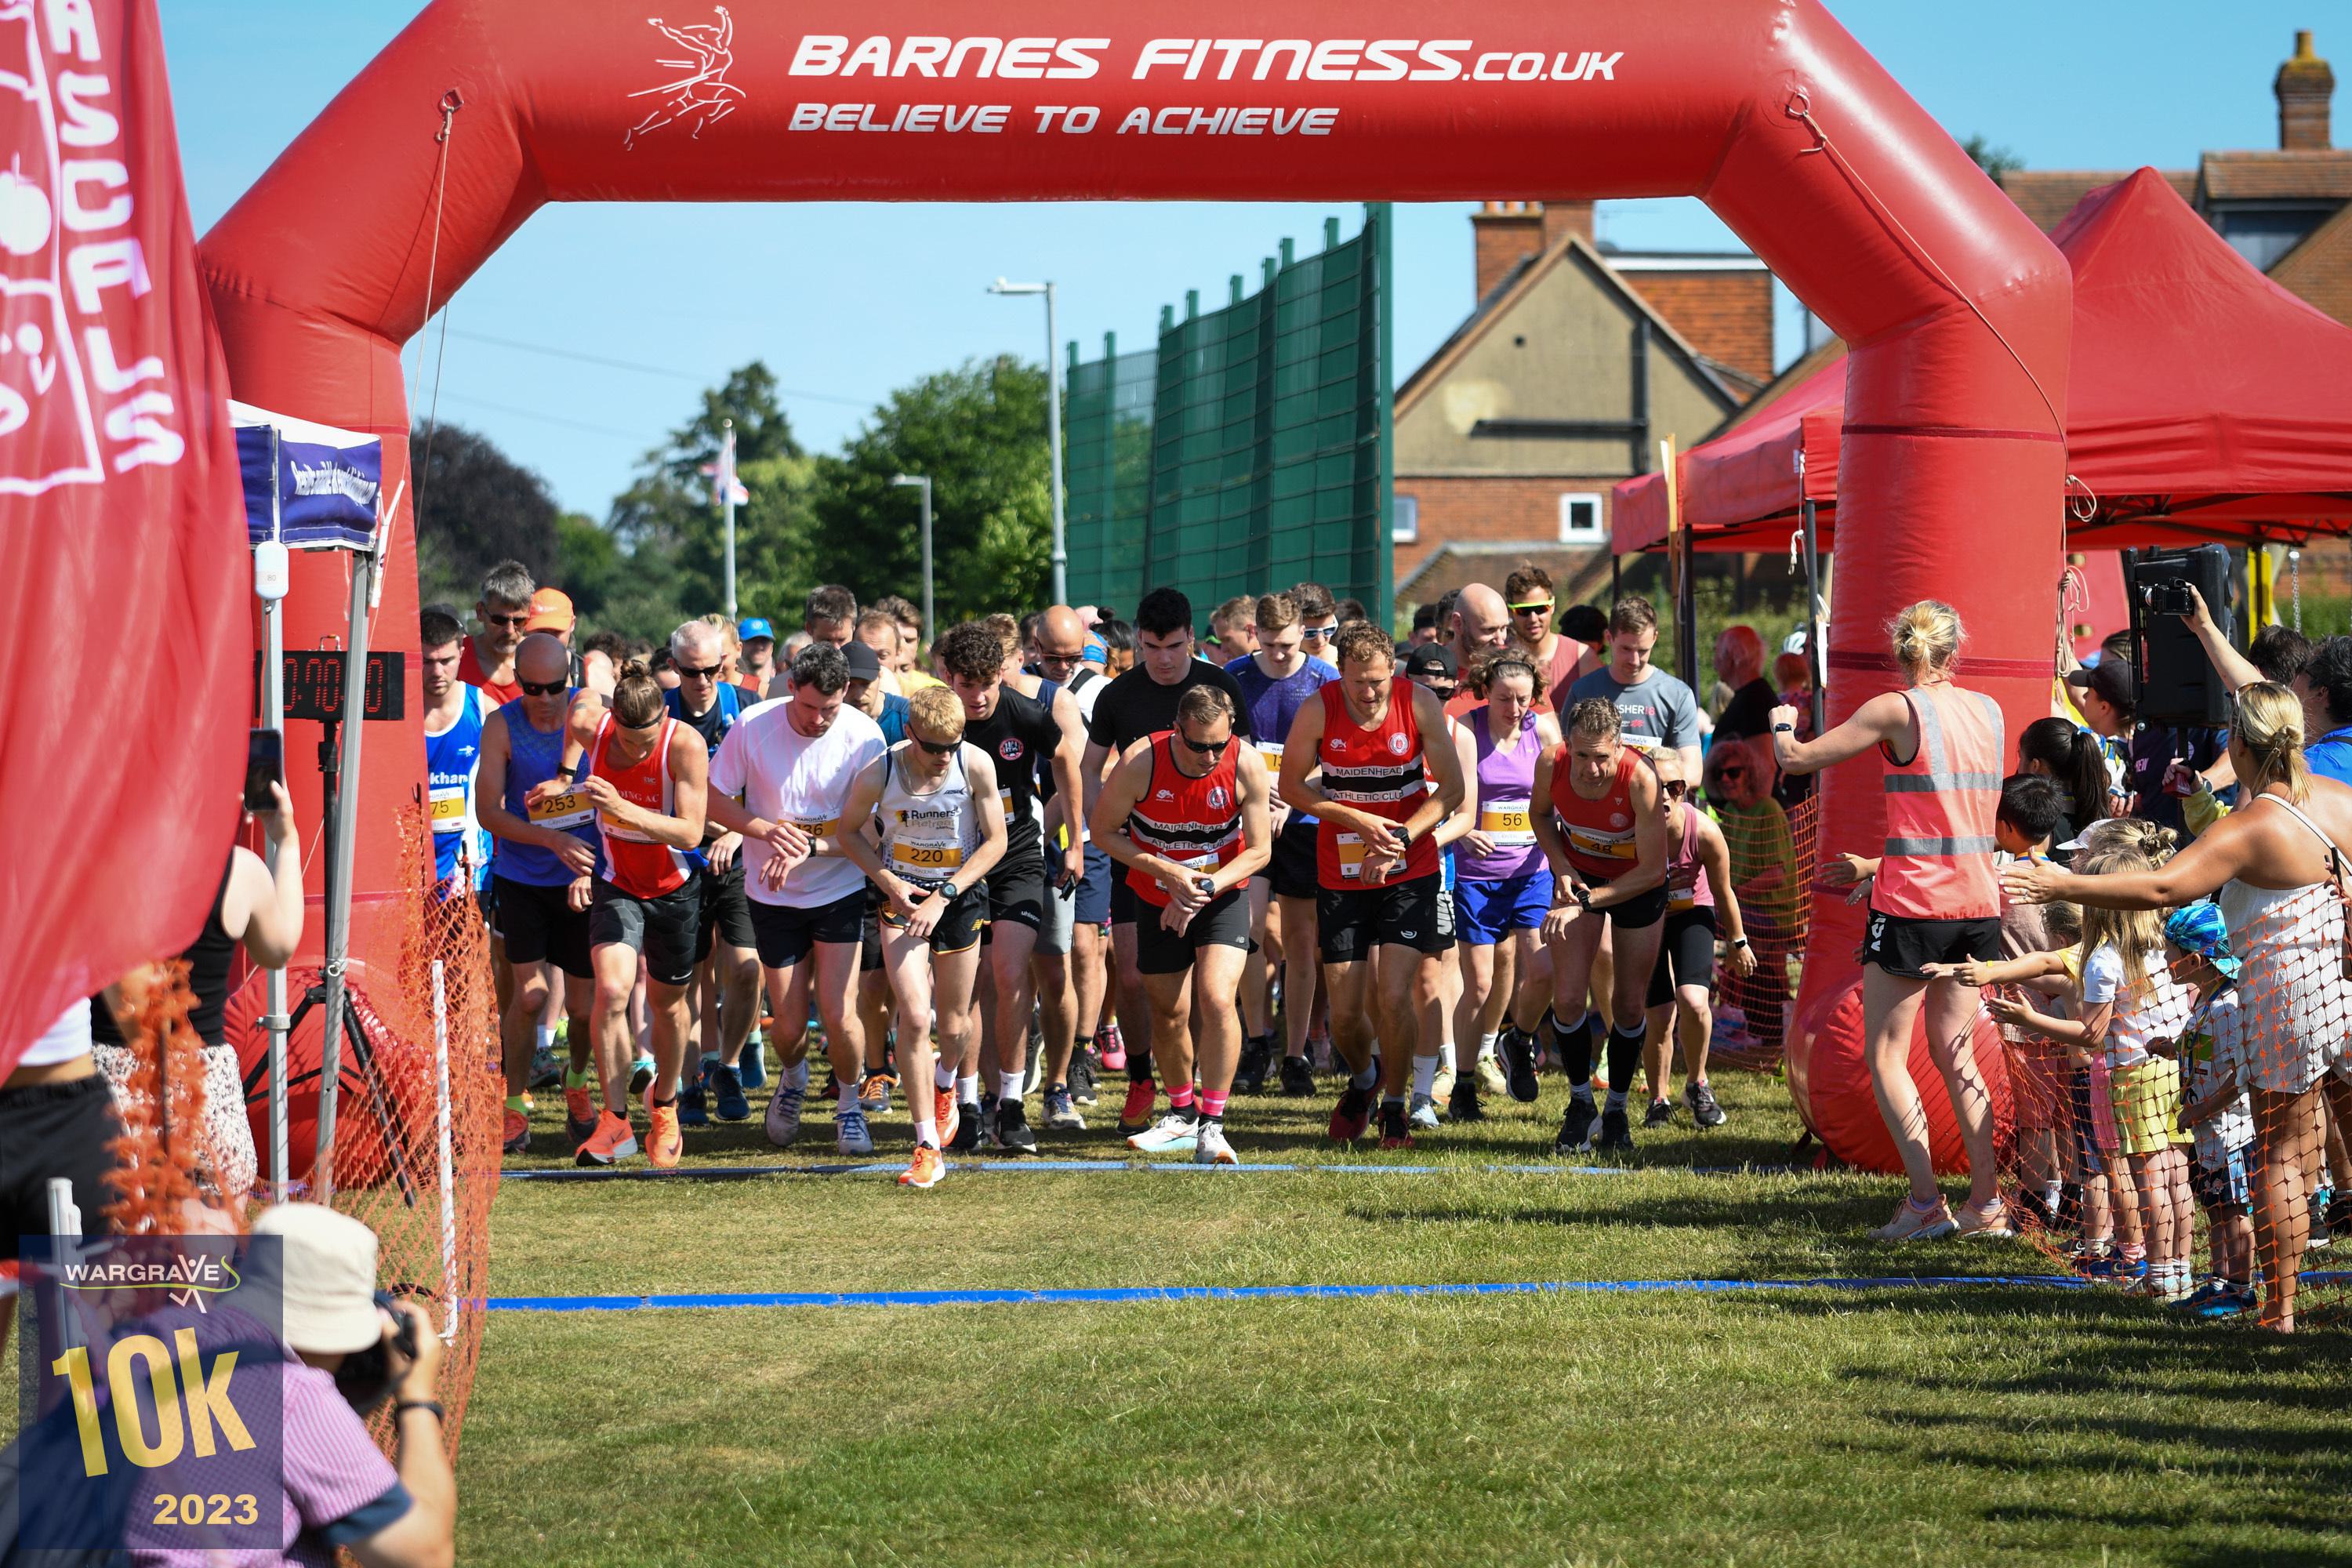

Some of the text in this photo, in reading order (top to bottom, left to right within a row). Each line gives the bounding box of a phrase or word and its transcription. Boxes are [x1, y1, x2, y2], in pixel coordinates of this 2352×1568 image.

[788, 34, 1624, 82] BARNES FITNESS.CO.UK
[789, 103, 1339, 135] BELIEVE TO ACHIEVE
[42, 0, 185, 473] ASCALS
[1336, 767, 1403, 777] MAIDENHEAD
[1333, 789, 1404, 802] ATHLETIC CLUB
[430, 800, 449, 815] 75
[544, 794, 576, 814] 253
[794, 814, 828, 822] WARGRAVE
[911, 818, 954, 829] Retrea
[1503, 813, 1523, 826] 56
[1153, 822, 1223, 831] MAIDENHEAD
[1151, 839, 1197, 851] ATHLETIC
[910, 848, 943, 862] 220
